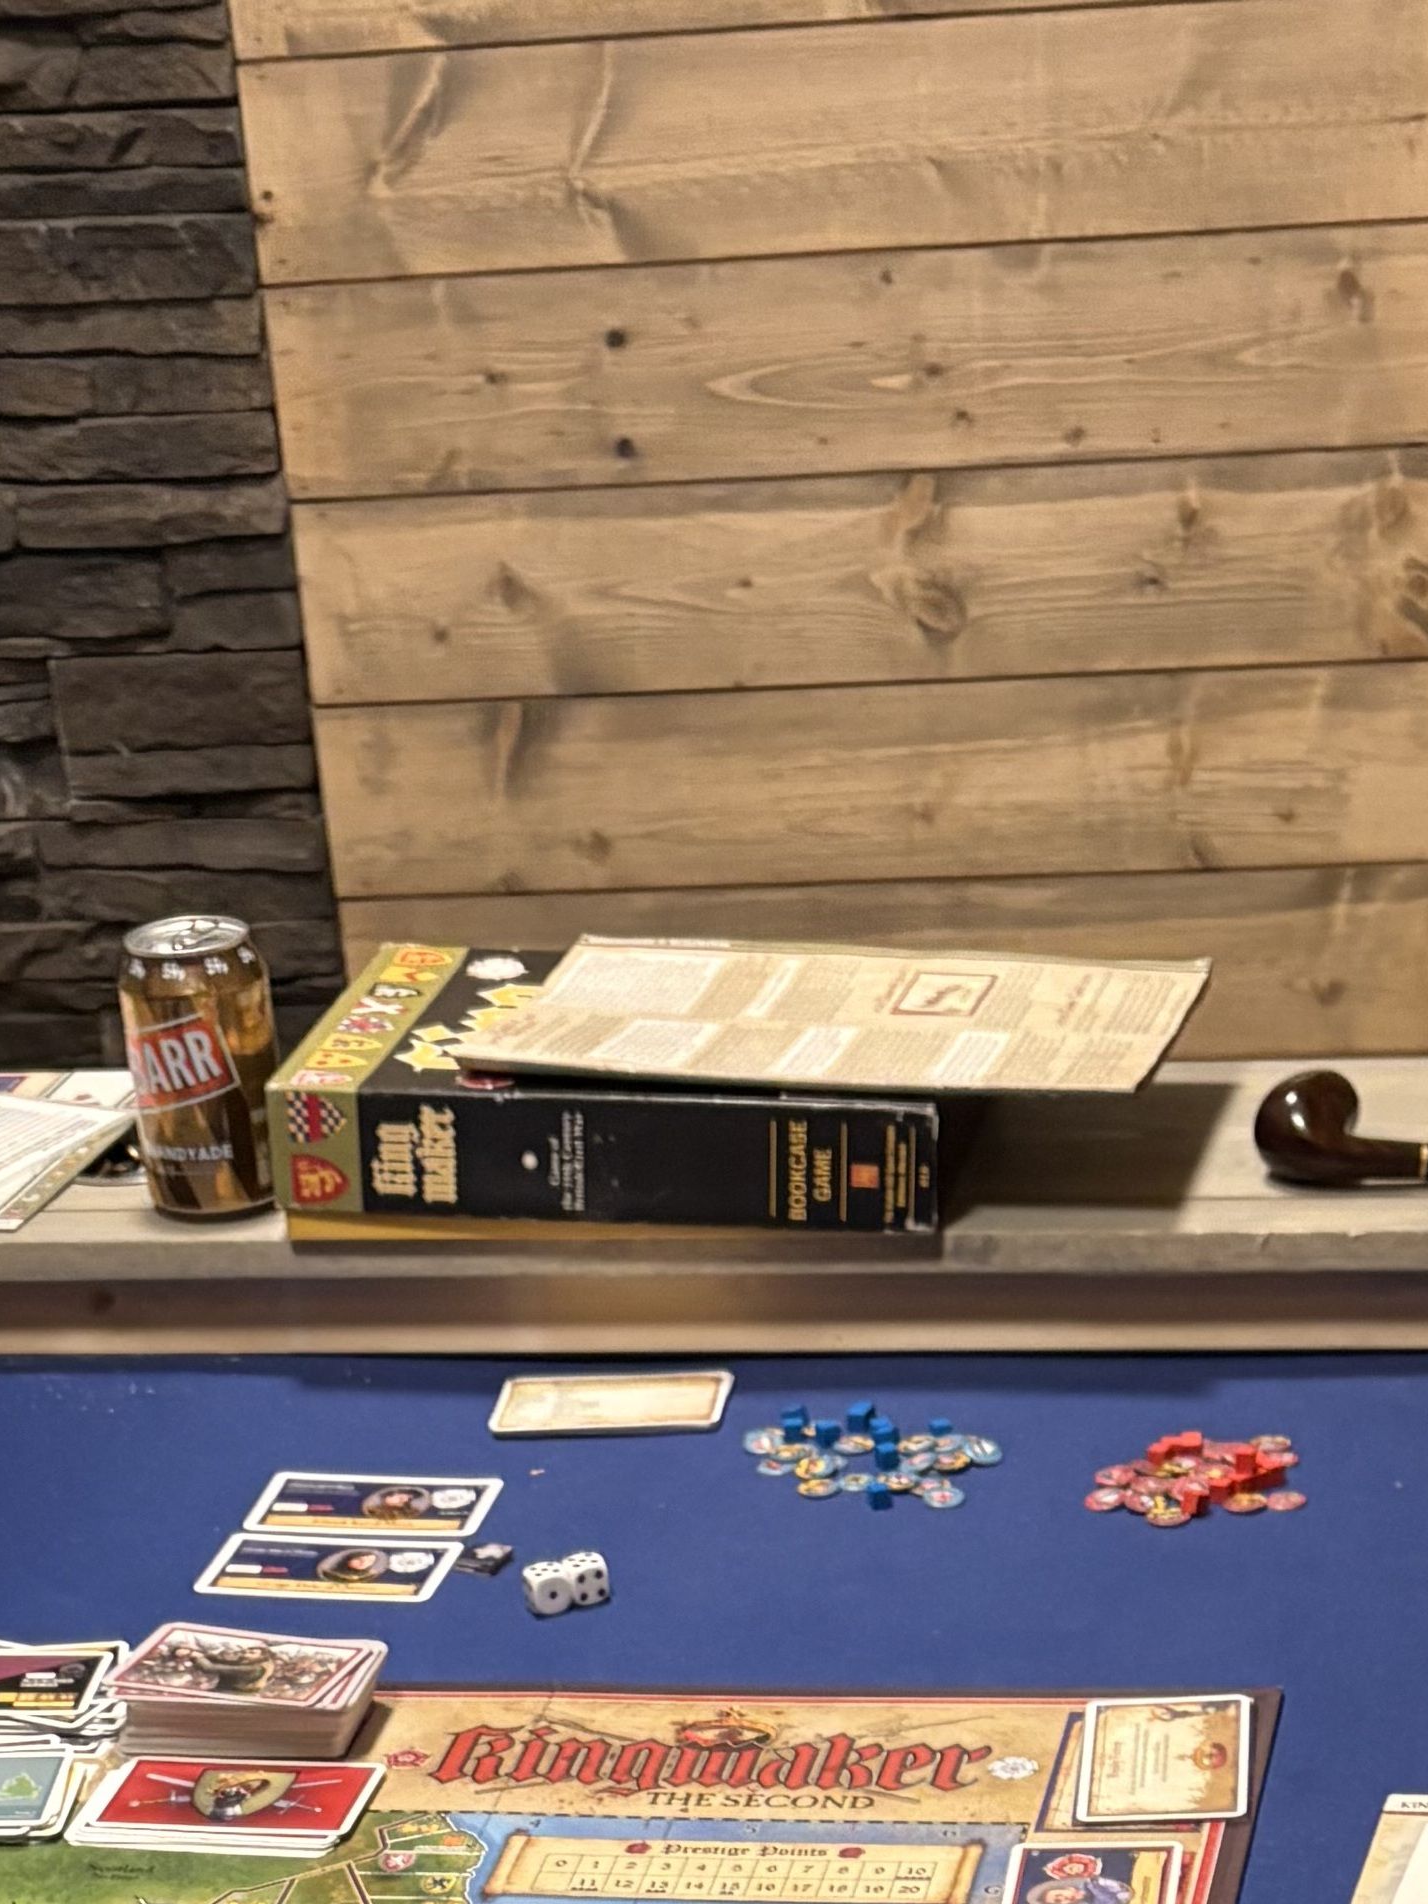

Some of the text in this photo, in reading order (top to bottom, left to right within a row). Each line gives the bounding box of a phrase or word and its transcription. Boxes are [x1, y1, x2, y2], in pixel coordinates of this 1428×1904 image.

[133, 1030, 223, 1094] ARR
[788, 1120, 807, 1221] BOOKCASE
[813, 1148, 832, 1202] GAME
[428, 1725, 991, 1798] Kingmaker
[647, 1791, 875, 1811] THE SECOND
[662, 1841, 829, 1860] Prestige Points
